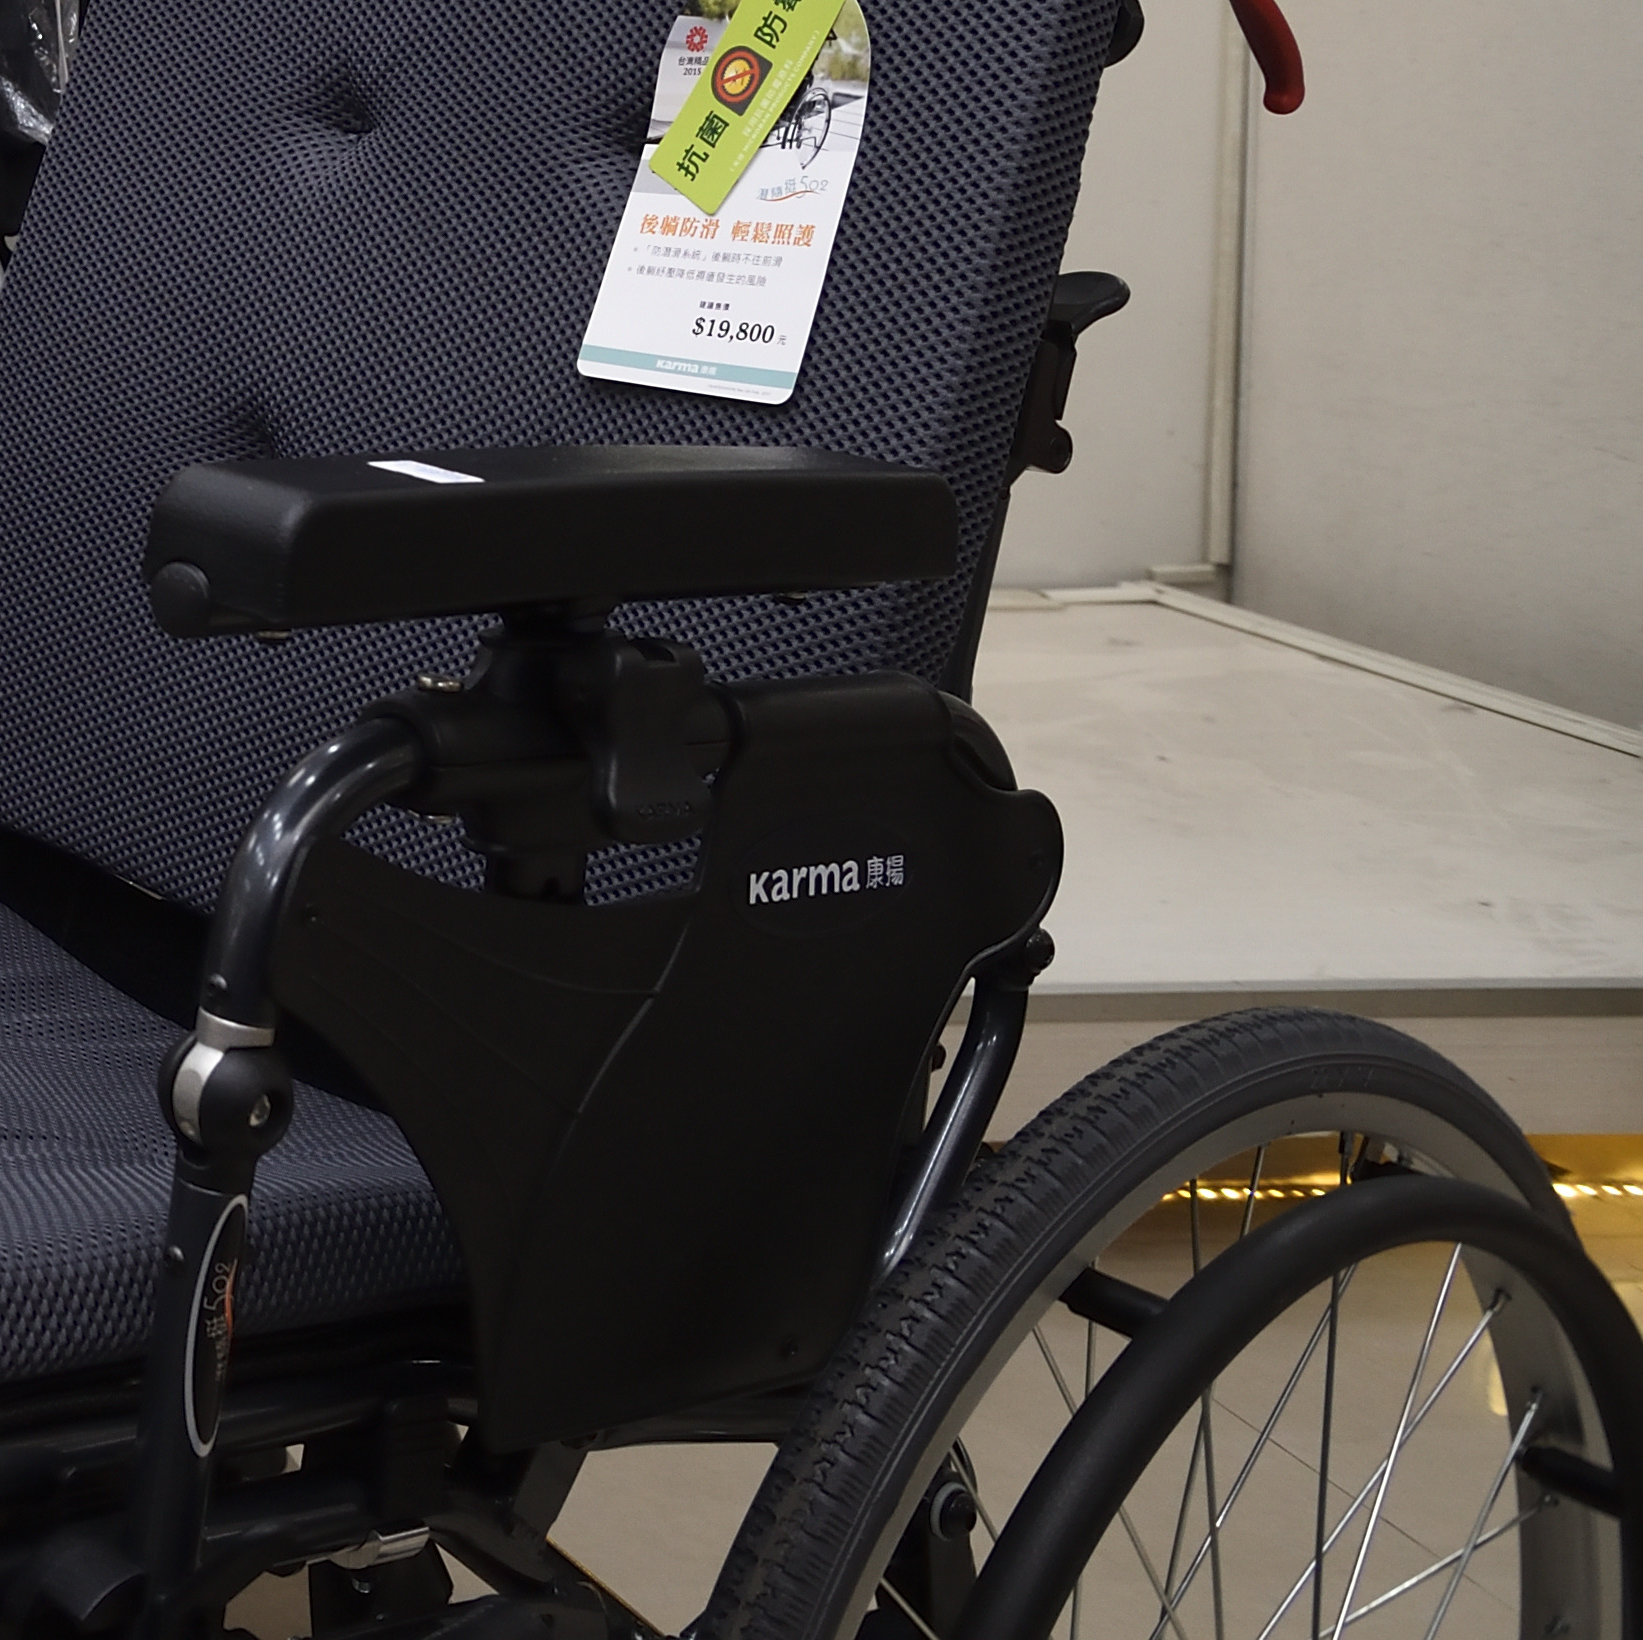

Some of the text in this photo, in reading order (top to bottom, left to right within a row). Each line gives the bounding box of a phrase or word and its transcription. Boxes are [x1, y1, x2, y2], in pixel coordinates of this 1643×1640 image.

[676, 110, 729, 182] 抗菌
[731, 220, 815, 247] 輕鬆照護
[692, 317, 775, 344] $19,800
